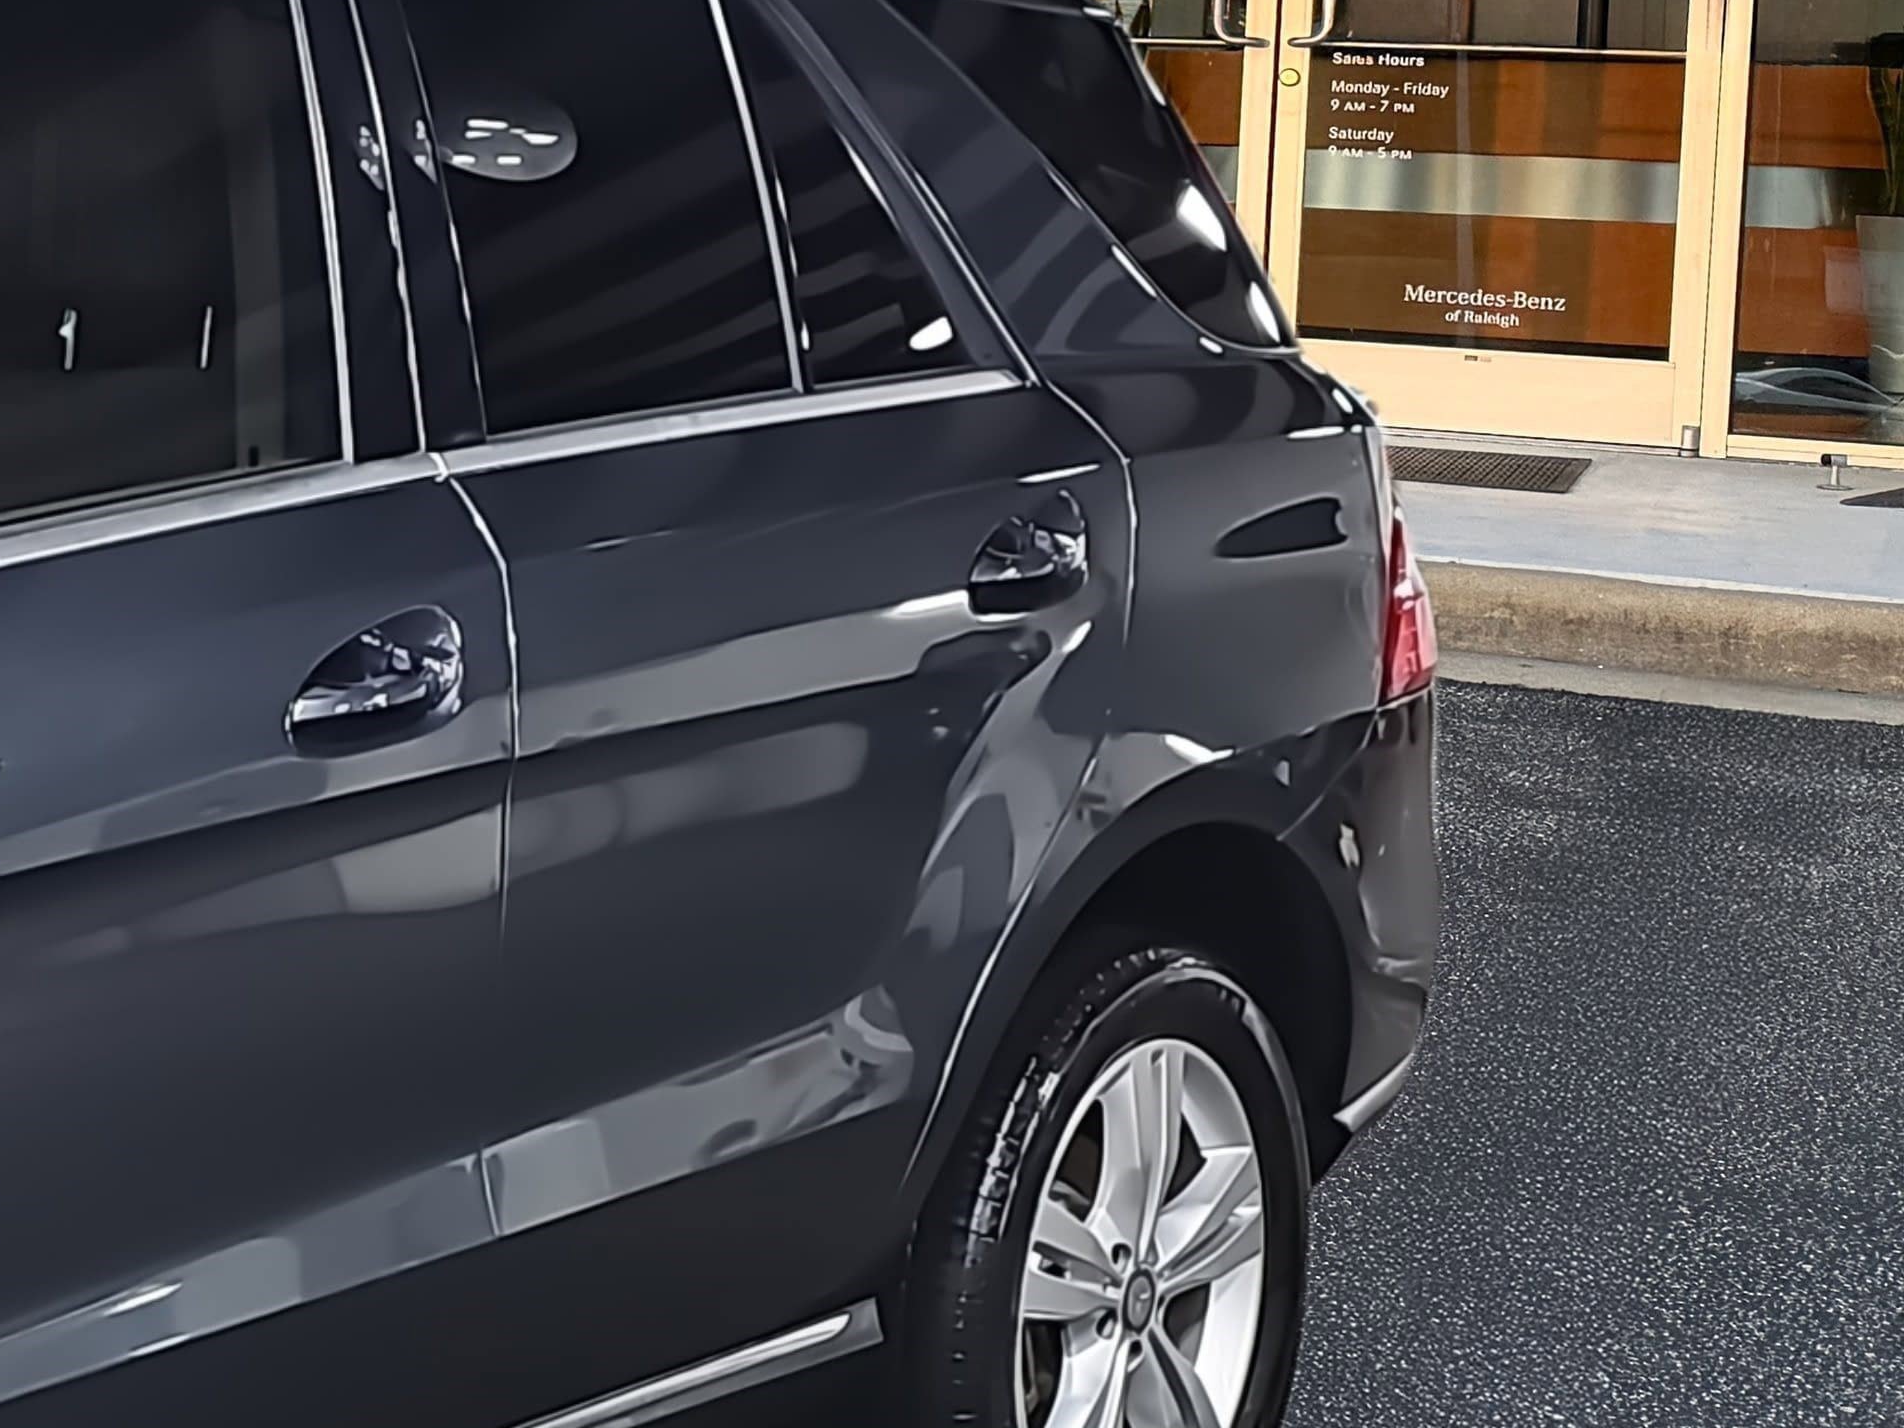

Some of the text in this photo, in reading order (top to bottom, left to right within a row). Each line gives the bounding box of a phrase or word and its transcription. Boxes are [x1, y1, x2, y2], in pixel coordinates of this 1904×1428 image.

[1378, 53, 1425, 67] Hours
[1331, 80, 1390, 97] Monday
[1403, 82, 1449, 99] Friday
[1330, 98, 1340, 111] 9
[1344, 101, 1366, 112] AM
[1380, 100, 1389, 112] 7
[1393, 103, 1415, 113] PM
[1328, 126, 1394, 144] Saturday
[1342, 148, 1364, 158] AM
[1377, 146, 1386, 159] 5
[1391, 150, 1412, 160] PM
[1404, 284, 1566, 311] Mercedes-Benz
[1445, 309, 1520, 328] of Raleigh
